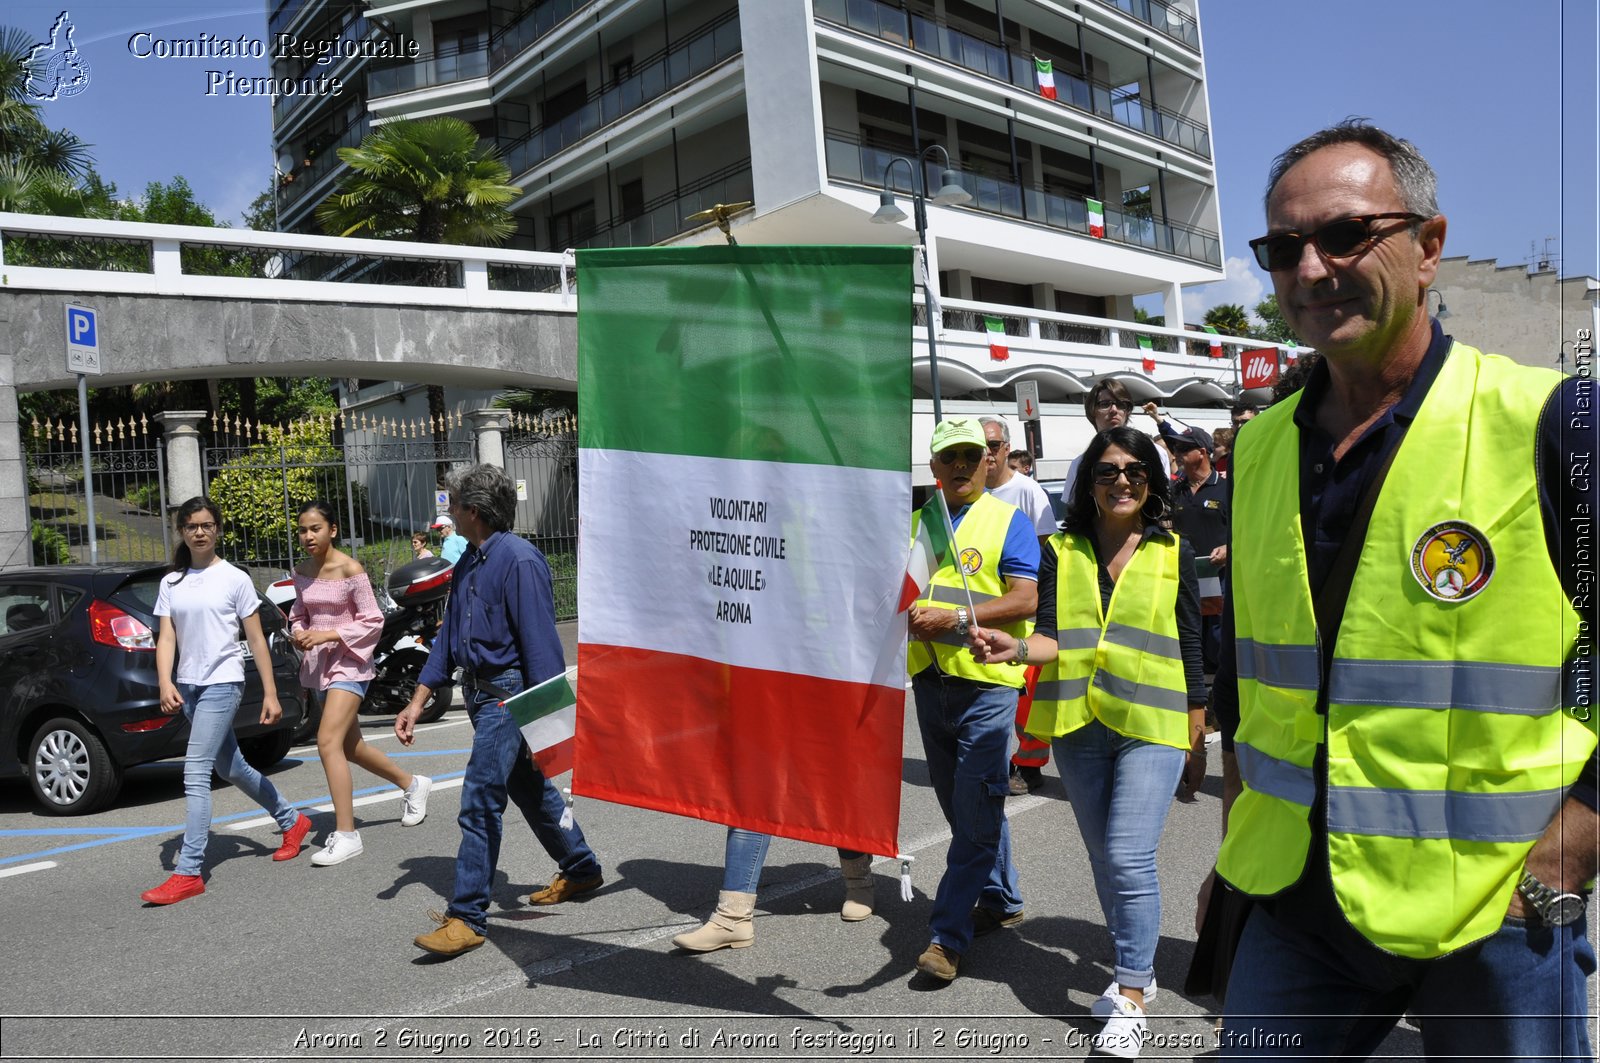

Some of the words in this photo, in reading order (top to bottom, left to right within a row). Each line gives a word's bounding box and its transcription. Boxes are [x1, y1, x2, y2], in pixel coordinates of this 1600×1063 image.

[74, 313, 90, 341] P
[1246, 356, 1274, 383] illy
[710, 497, 767, 523] VOLONTARI
[690, 529, 752, 556] PROTEZIONE
[753, 536, 786, 560] CIVILE
[708, 565, 722, 587] «LE
[723, 567, 767, 592] AQUILE»
[716, 600, 752, 624] ARONA
